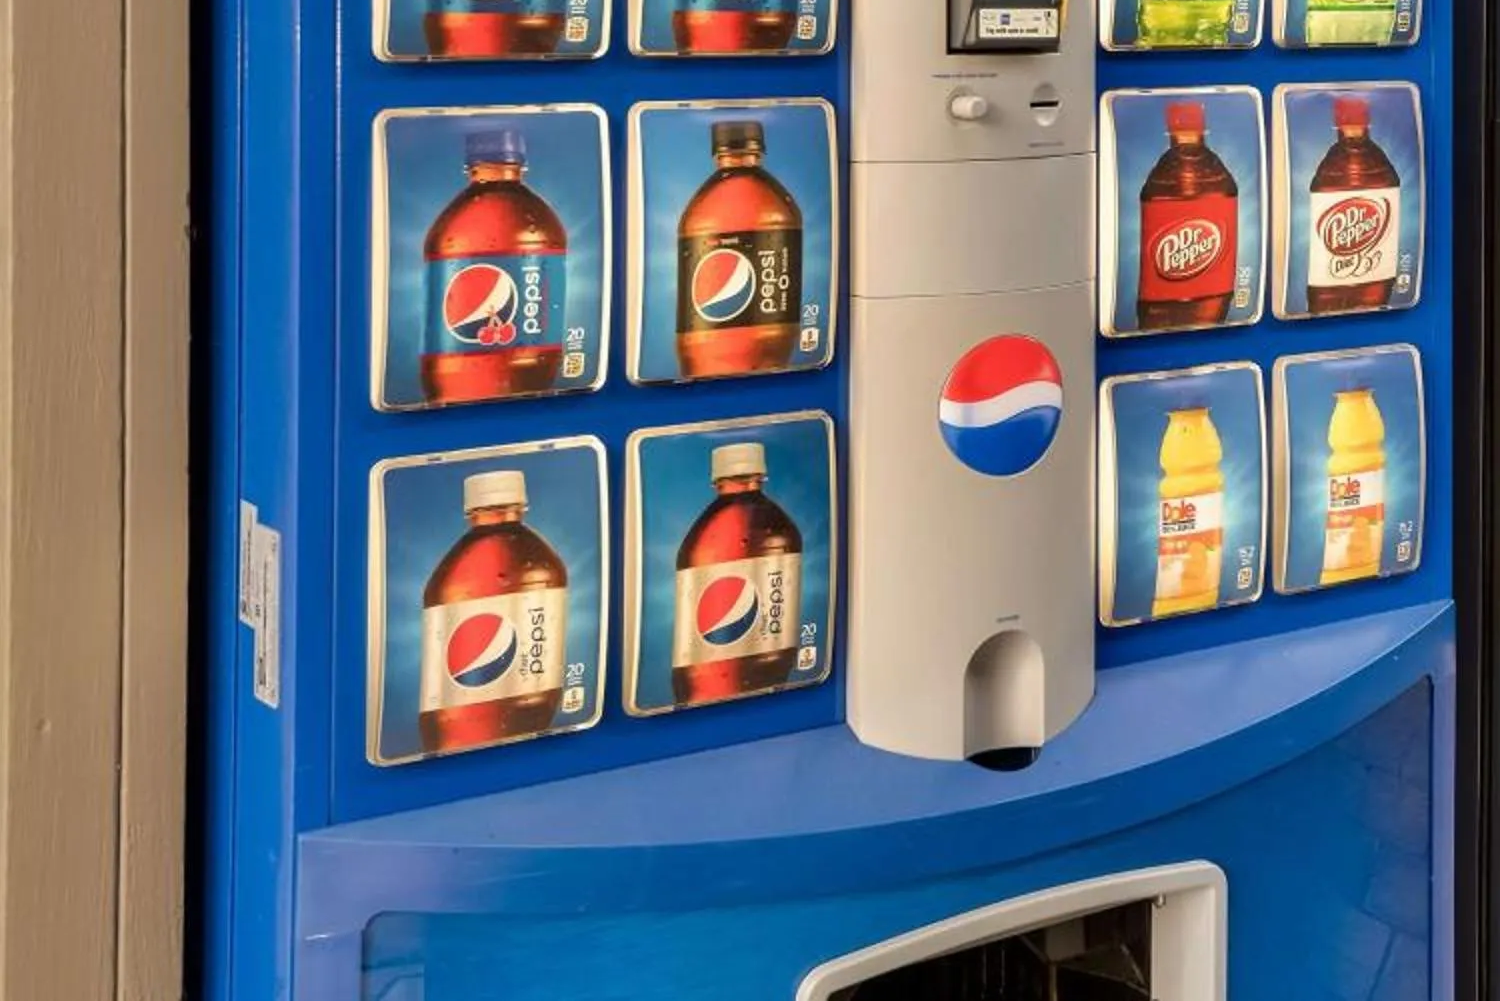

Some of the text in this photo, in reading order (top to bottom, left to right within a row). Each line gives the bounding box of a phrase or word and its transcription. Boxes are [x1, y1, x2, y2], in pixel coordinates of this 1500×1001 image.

[1328, 212, 1379, 250] Pepper
[1348, 206, 1367, 227] Dr
[1158, 234, 1217, 272] Pepper
[1179, 226, 1203, 249] Dr
[523, 265, 543, 334] pepsi
[757, 249, 777, 313] pepsi
[1330, 476, 1361, 498] Dole
[1162, 501, 1196, 522] Dole
[767, 569, 785, 634] pepsi
[528, 606, 546, 674] pepsi
